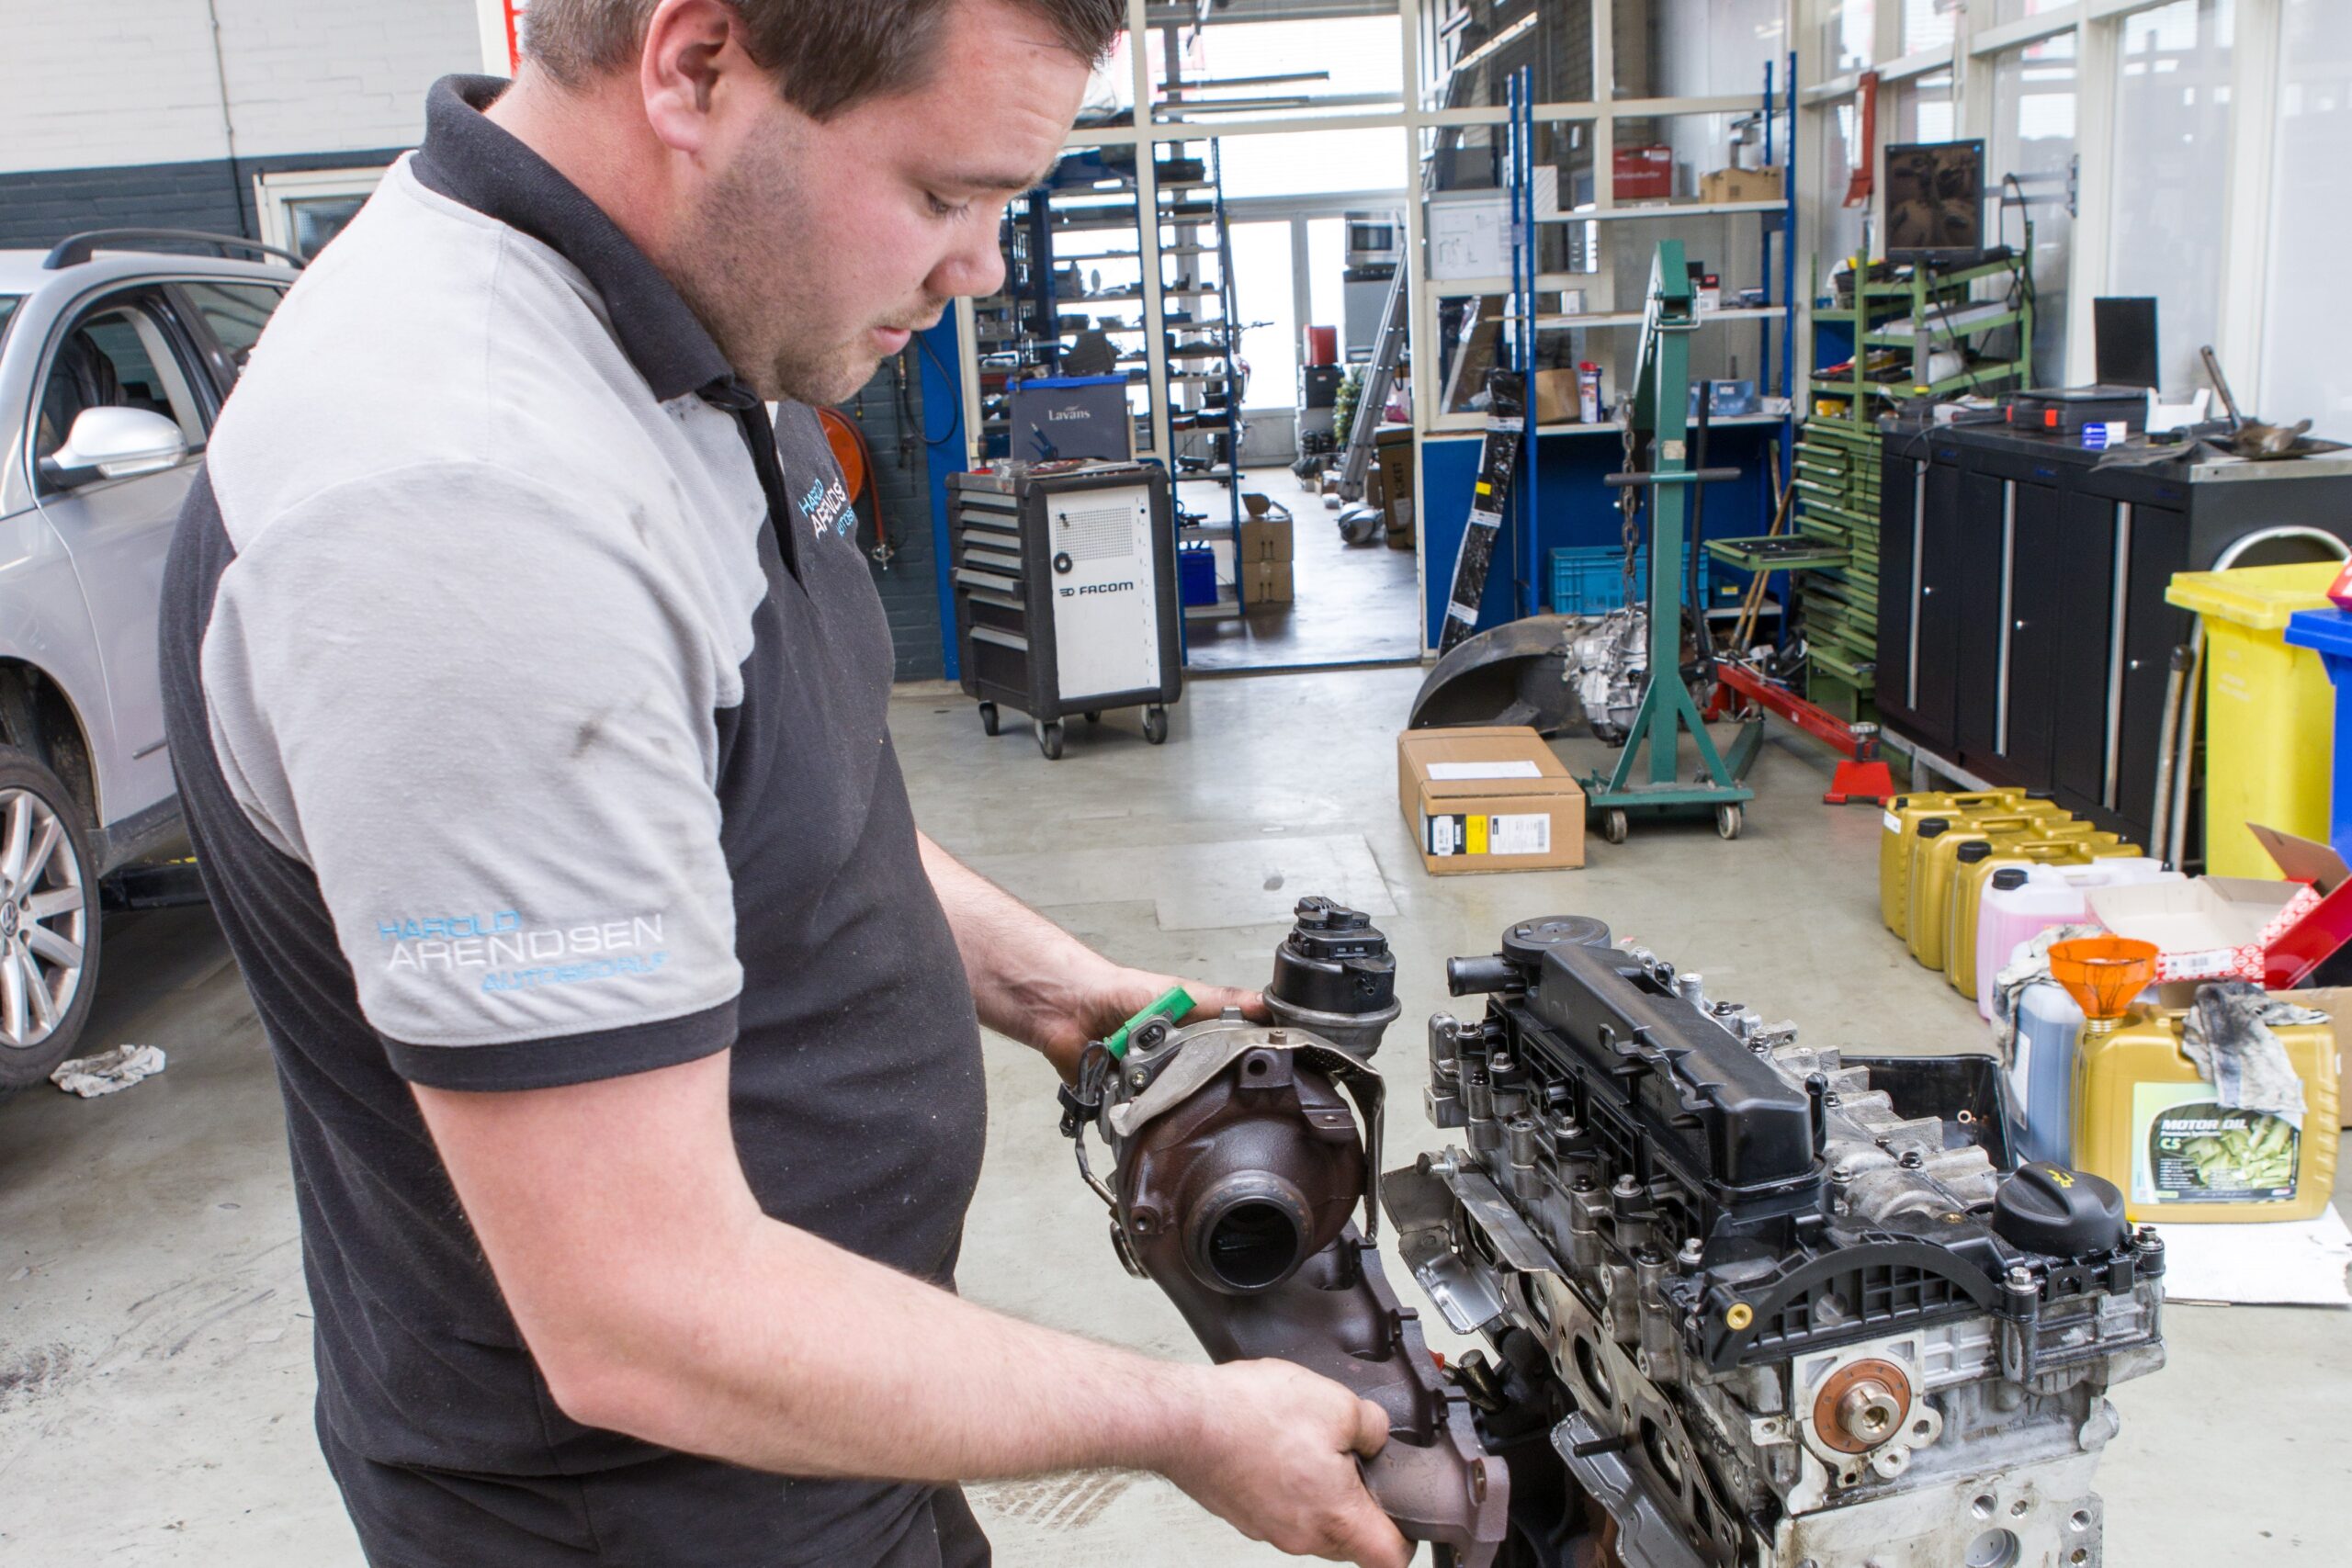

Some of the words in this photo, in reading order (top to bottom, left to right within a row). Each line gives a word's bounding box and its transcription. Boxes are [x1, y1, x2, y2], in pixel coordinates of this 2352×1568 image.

[1048, 409, 1091, 421] Lavans
[1080, 581, 1134, 595] FACOM
[378, 910, 521, 940] HAROLD
[387, 913, 664, 973] ARENDSEN
[2160, 1119, 2220, 1131] MOTOR
[2222, 1118, 2248, 1130] OIL
[2159, 1138, 2182, 1150] C5
